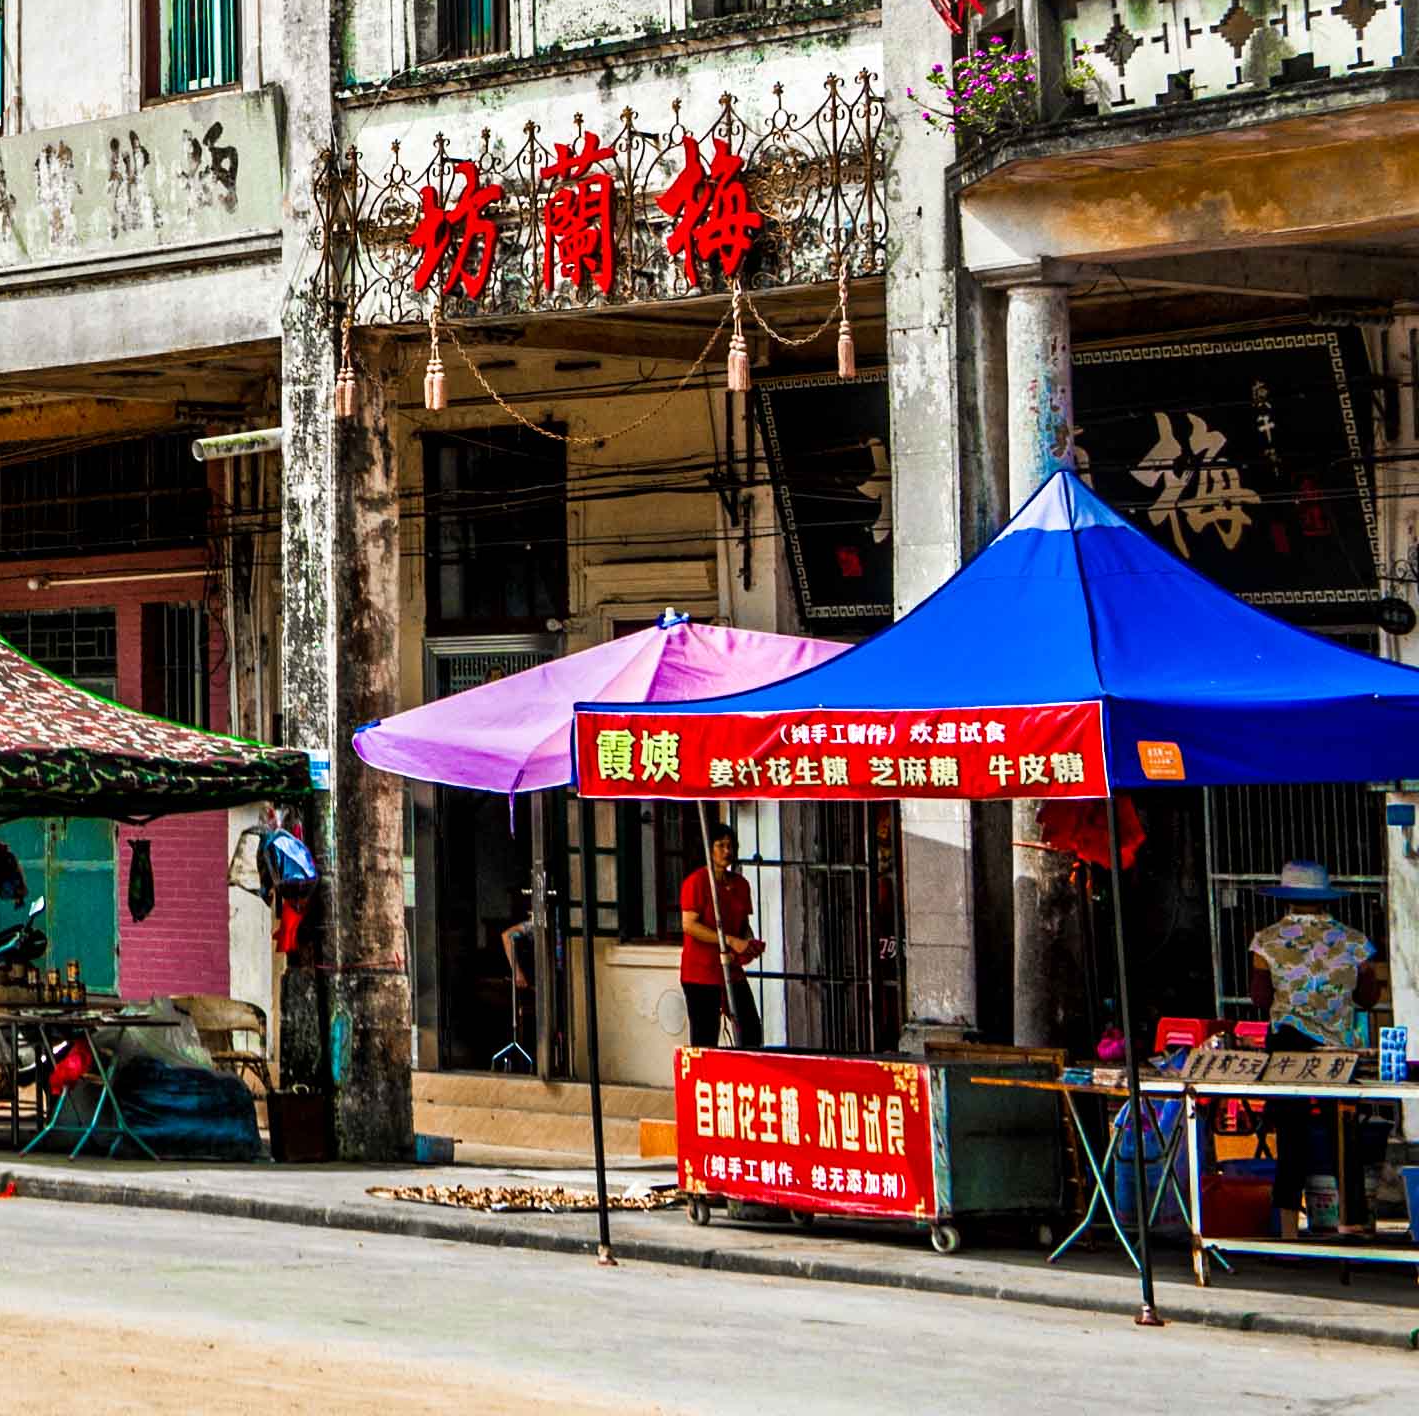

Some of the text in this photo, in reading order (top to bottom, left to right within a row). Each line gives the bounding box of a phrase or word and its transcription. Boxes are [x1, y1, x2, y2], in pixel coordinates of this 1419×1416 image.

[910, 721, 1006, 744] 欢迎试食
[596, 730, 681, 782] 霞姨
[708, 753, 1085, 788] 姜汁花生糖 芝麻糖 牛皮糖
